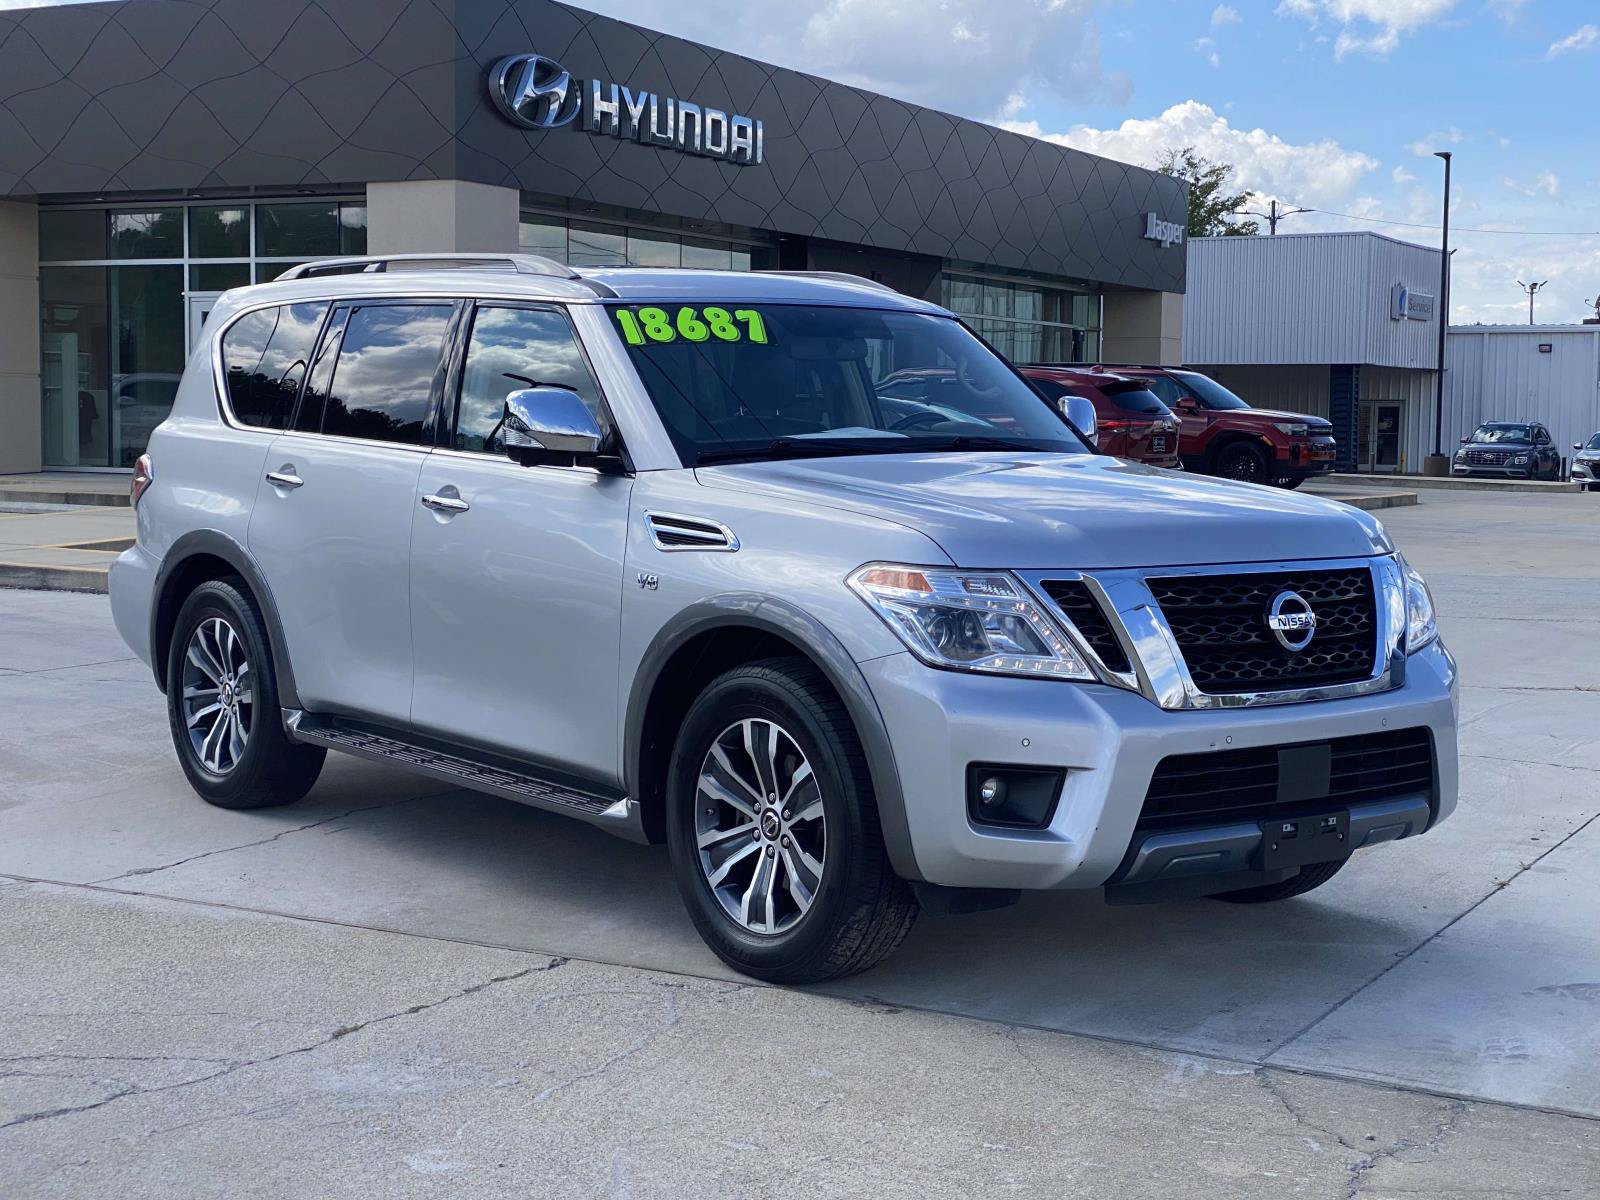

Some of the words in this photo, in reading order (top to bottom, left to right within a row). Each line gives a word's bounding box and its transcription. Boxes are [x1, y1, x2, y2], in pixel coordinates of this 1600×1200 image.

[588, 79, 763, 165] HYUNDAI
[1144, 211, 1185, 248] Jasper
[616, 306, 768, 345] 18687
[637, 572, 659, 591] V8
[1277, 615, 1316, 628] NISSAN
